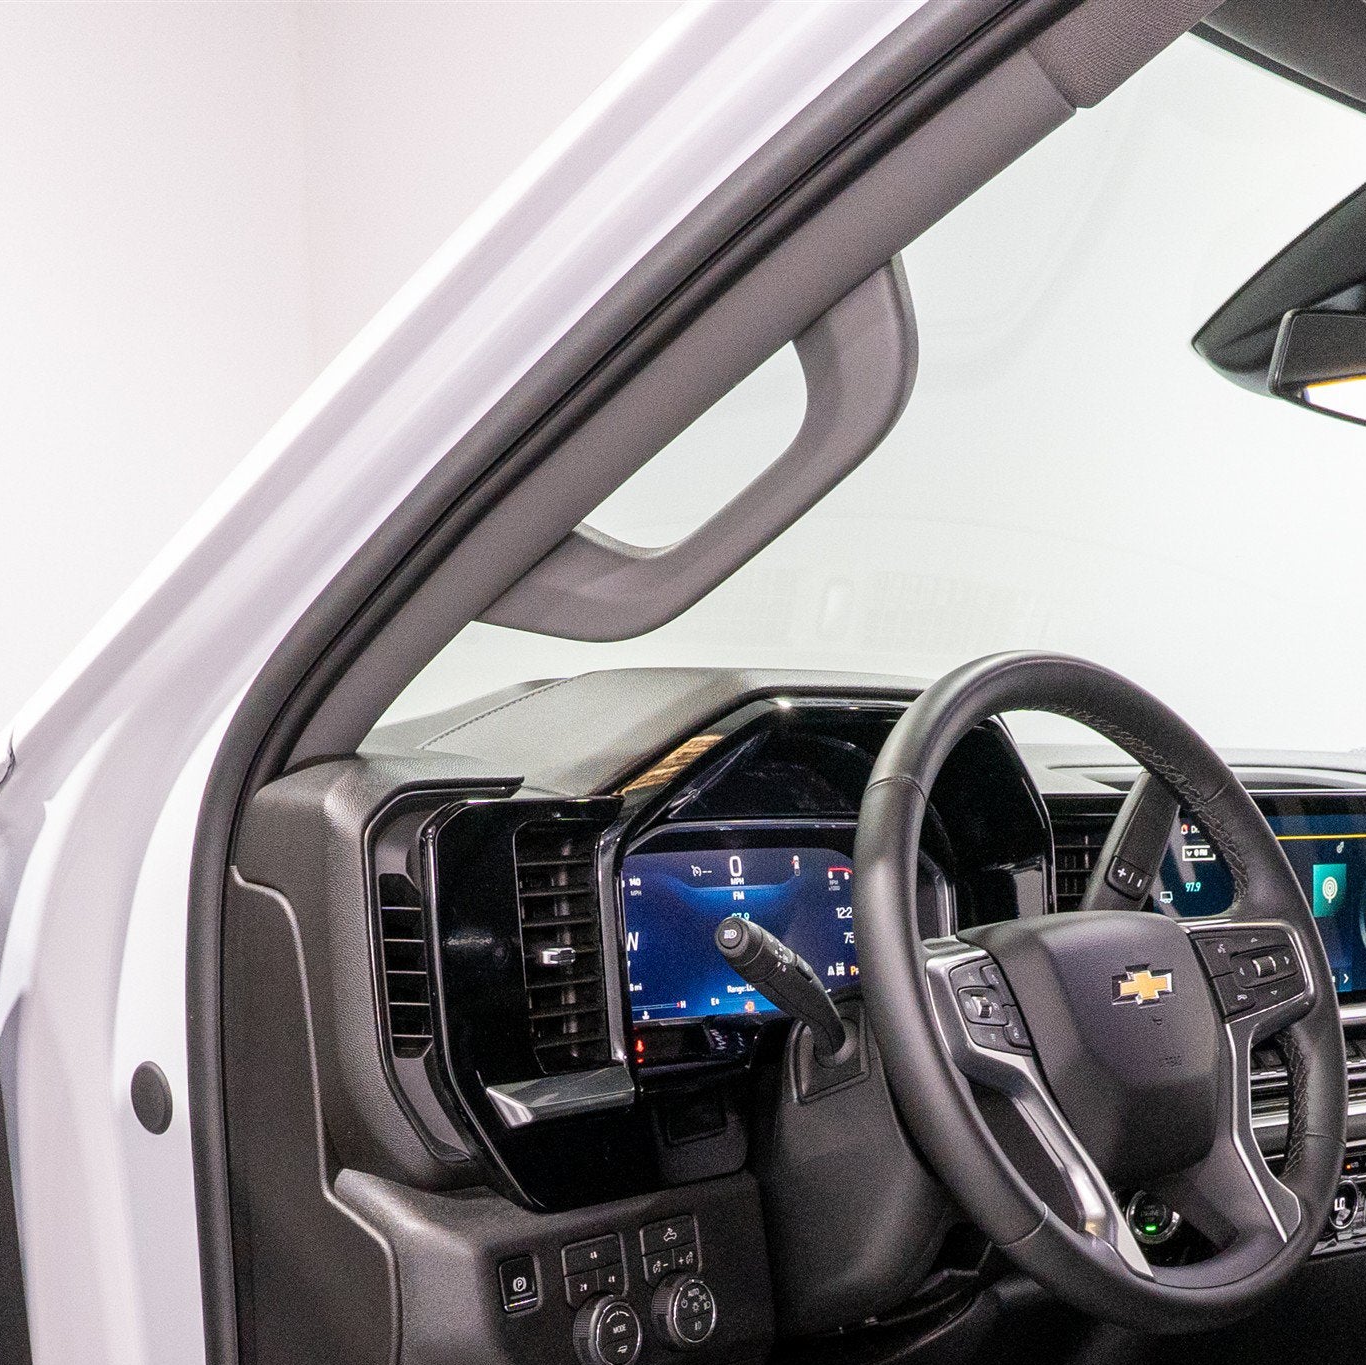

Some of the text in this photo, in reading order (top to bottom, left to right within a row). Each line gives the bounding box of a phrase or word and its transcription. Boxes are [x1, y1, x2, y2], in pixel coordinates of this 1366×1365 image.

[729, 855, 742, 877] 0
[730, 877, 744, 885] MPH
[1185, 881, 1202, 893] 97.9
[733, 891, 745, 901] FM
[612, 1324, 626, 1334] MODE
